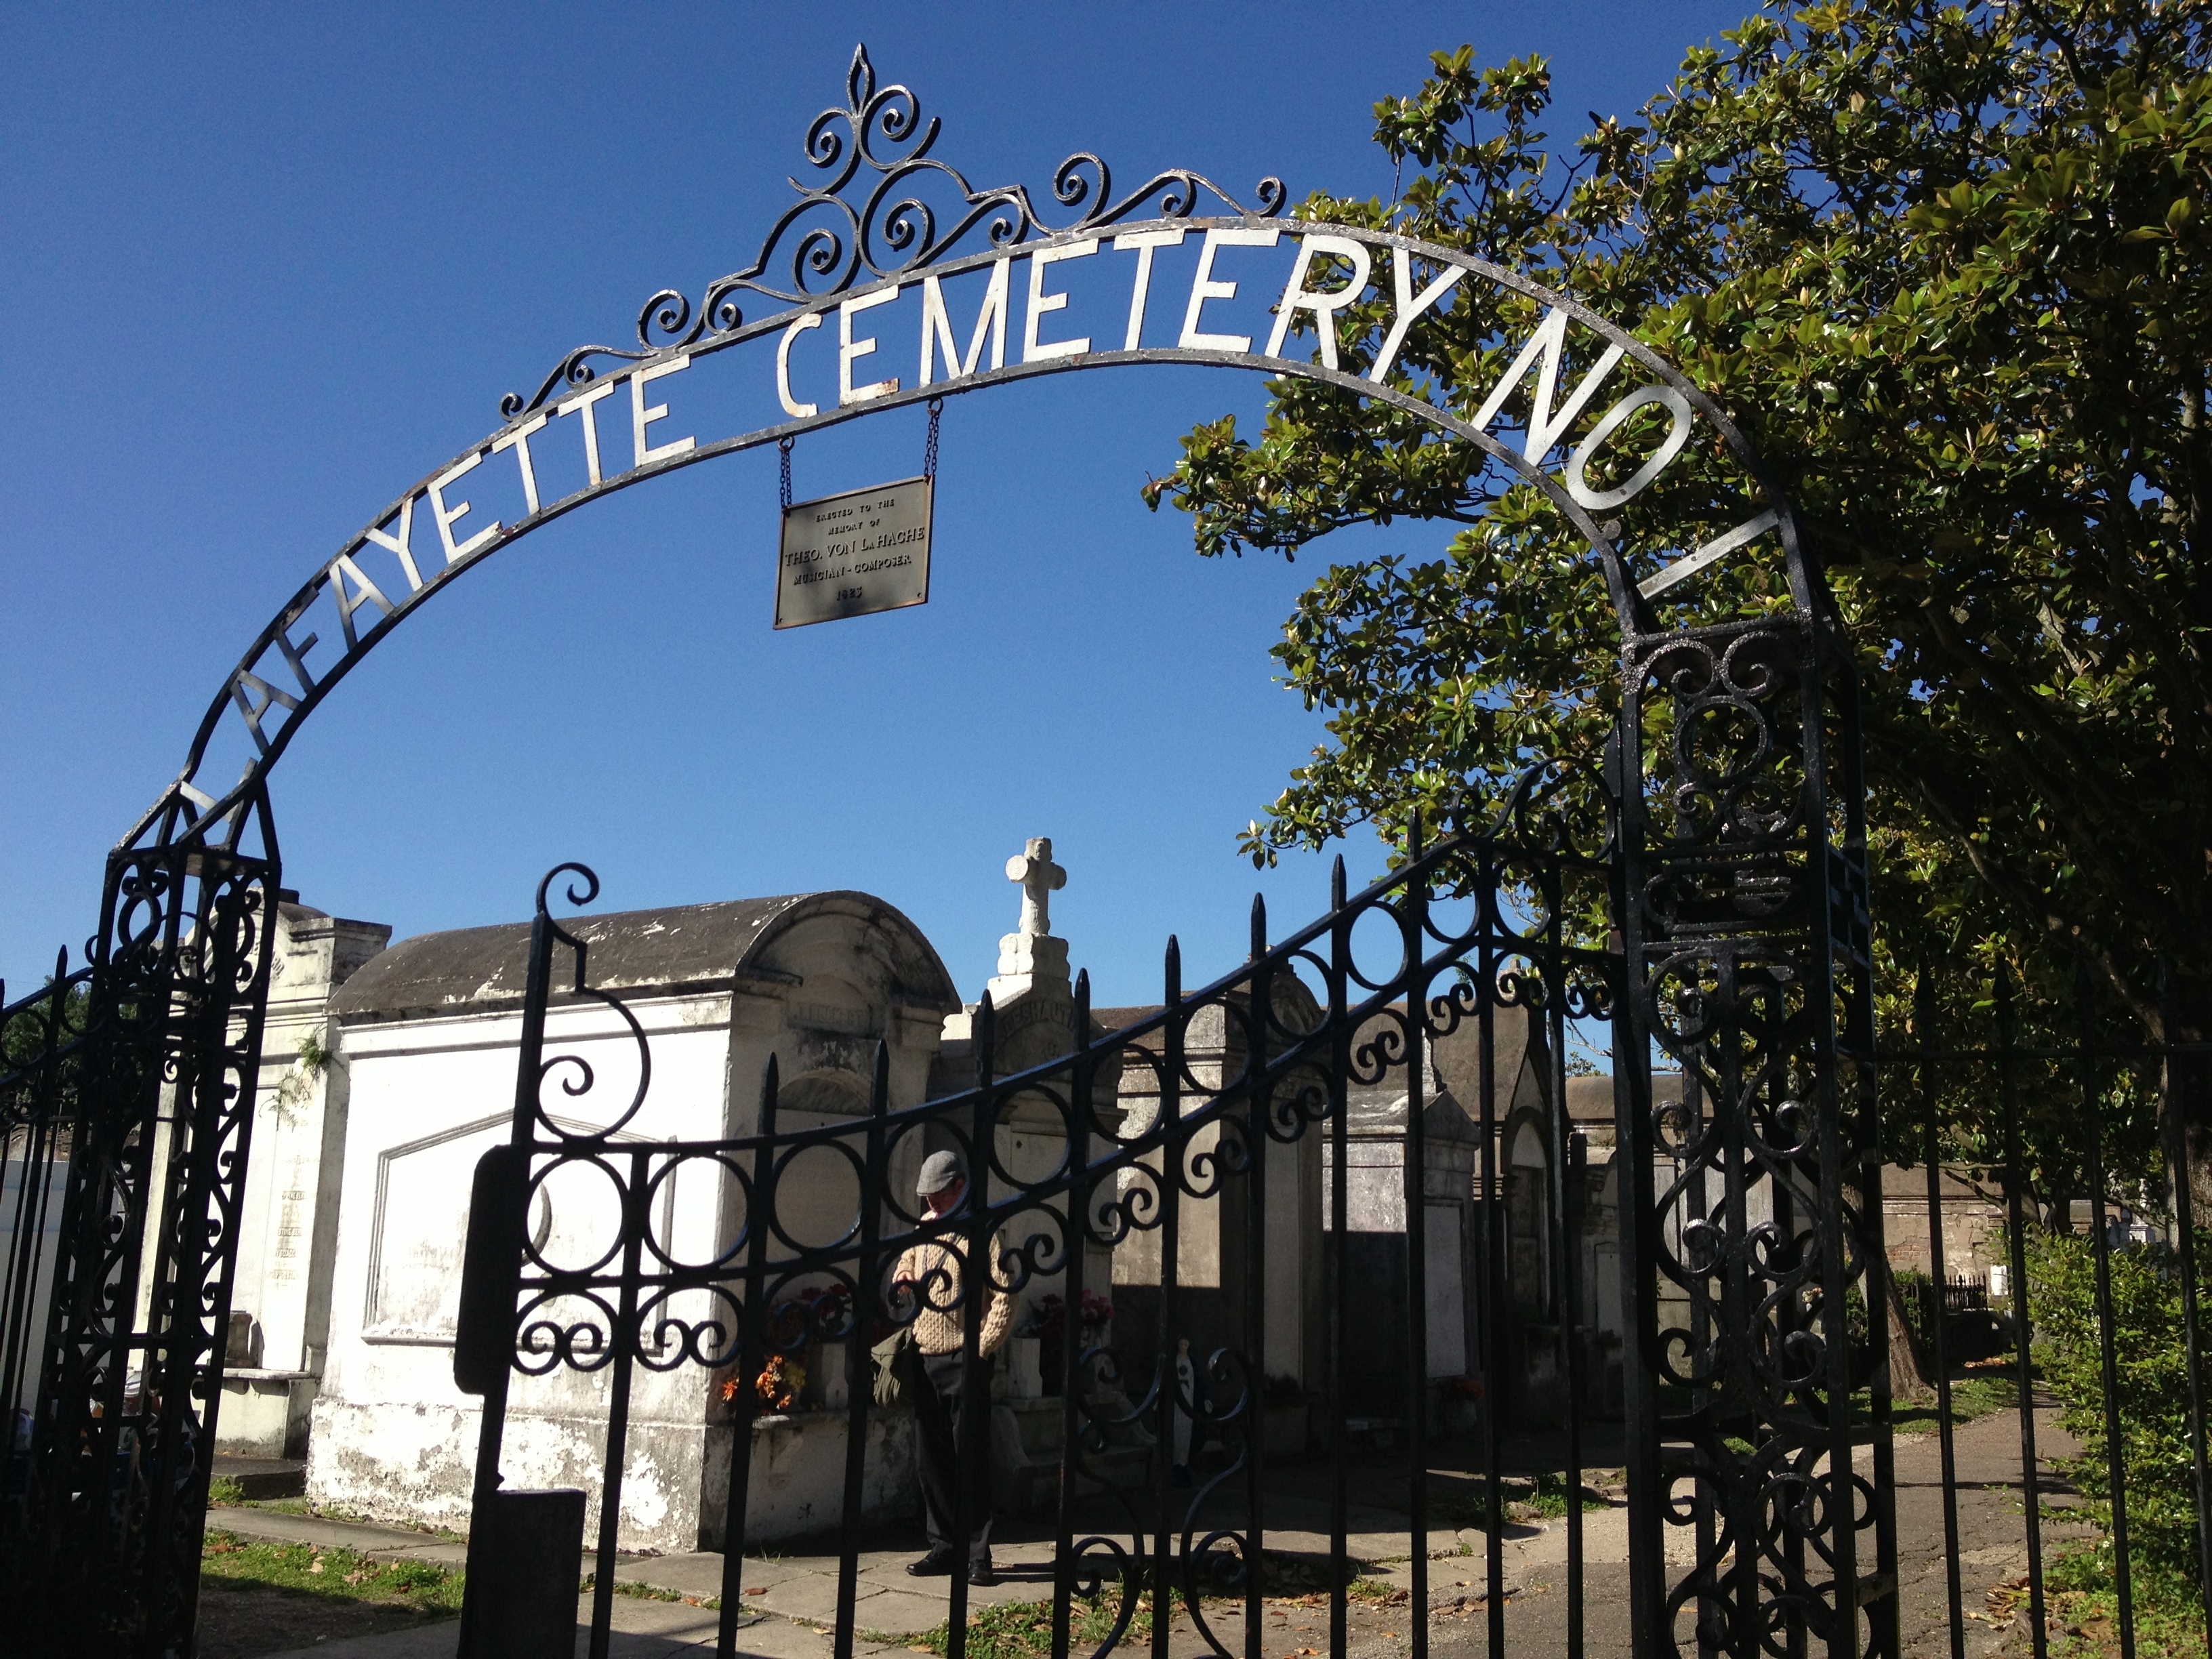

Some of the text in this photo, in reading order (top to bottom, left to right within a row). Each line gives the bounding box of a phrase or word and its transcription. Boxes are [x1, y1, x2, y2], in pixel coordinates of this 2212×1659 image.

[816, 498, 895, 523] ERECTED TO THE
[180, 354, 695, 823] LAFAYETTE
[777, 228, 1469, 419] CEMETERY
[1637, 508, 1780, 601] 1
[828, 518, 880, 535] MEMORY OF
[785, 548, 823, 567] THEO.
[826, 539, 856, 558] VON
